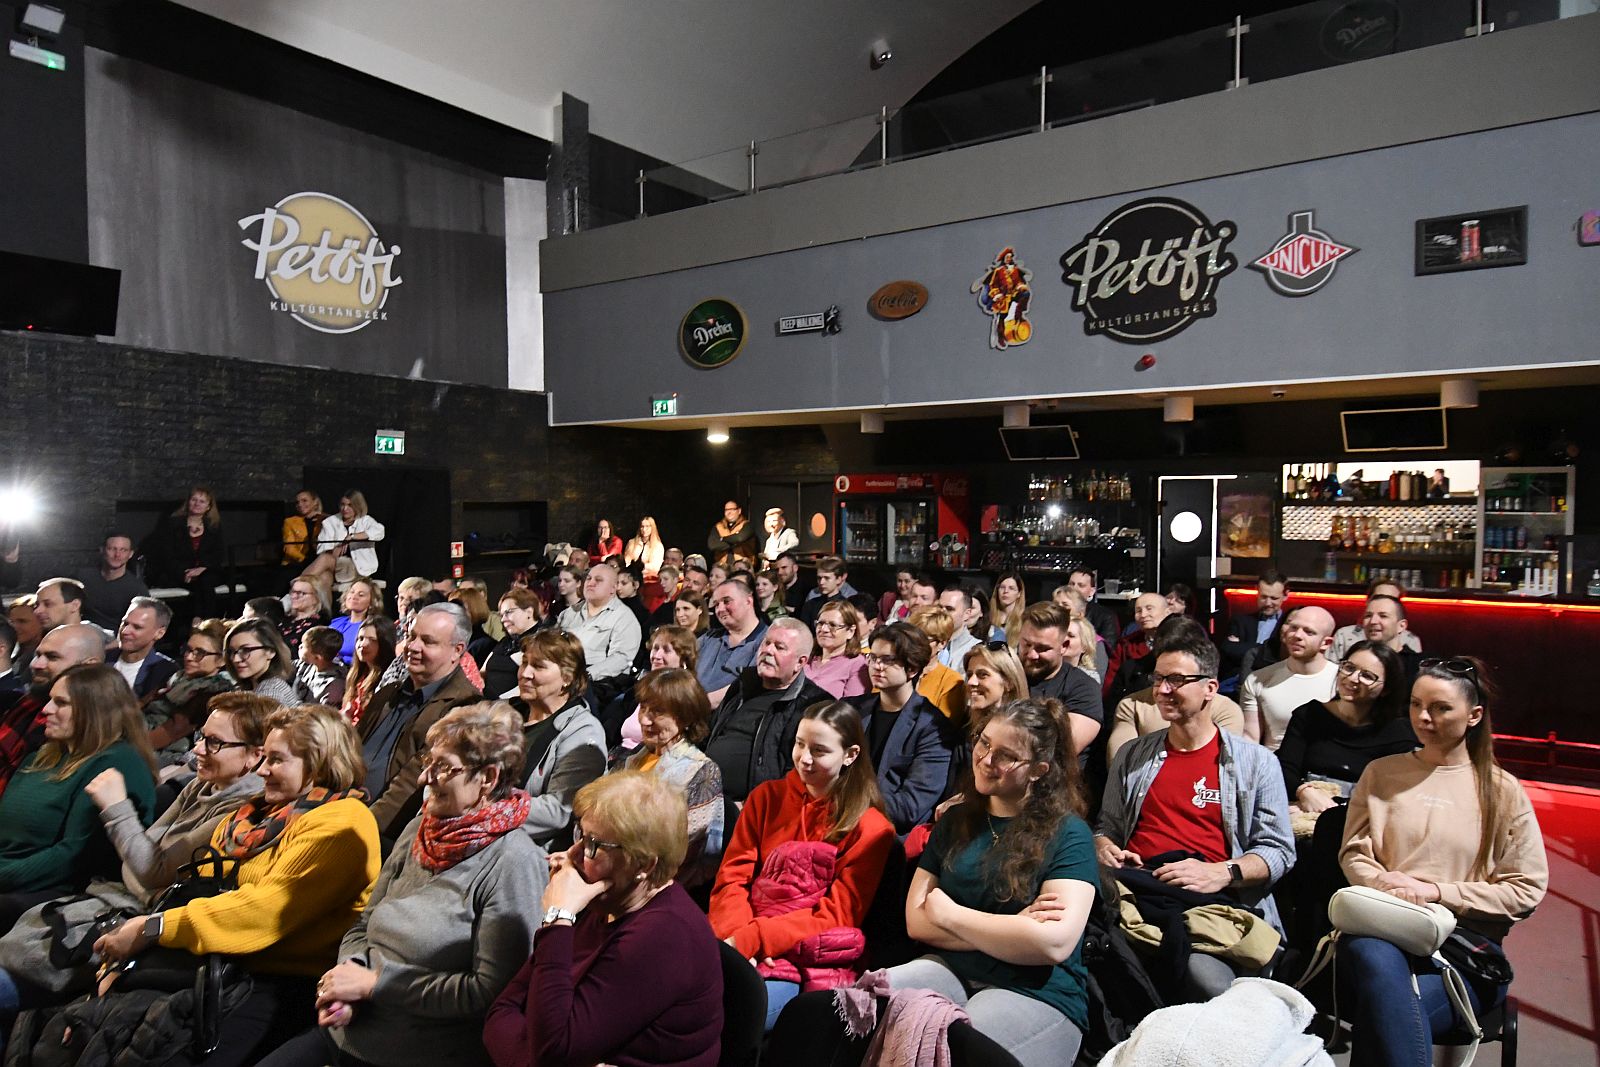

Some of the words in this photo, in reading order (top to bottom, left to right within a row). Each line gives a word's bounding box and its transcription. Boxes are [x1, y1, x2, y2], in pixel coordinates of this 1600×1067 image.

[1265, 238, 1340, 274] UNICUM
[693, 320, 733, 347] Dreher
[782, 319, 796, 329] KEEP
